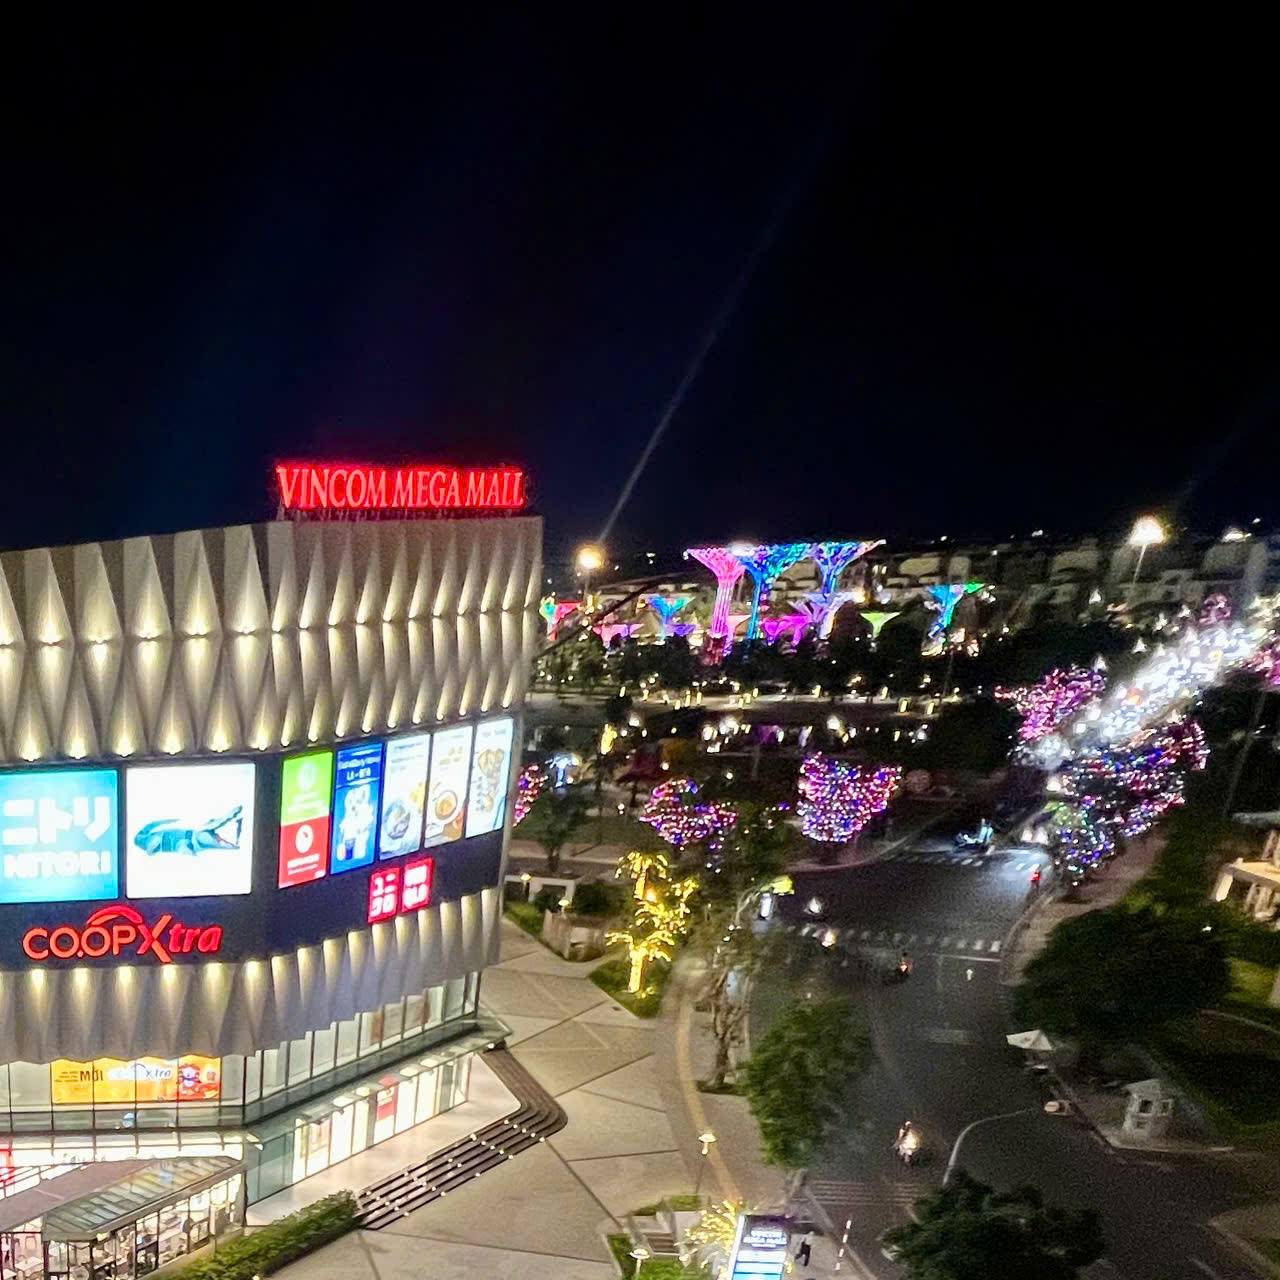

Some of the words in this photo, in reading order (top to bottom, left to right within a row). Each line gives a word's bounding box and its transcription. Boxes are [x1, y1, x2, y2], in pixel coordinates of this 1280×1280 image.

[275, 467, 388, 509] VINCOM
[391, 469, 461, 509] MEGA
[464, 470, 524, 508] MALL
[2, 796, 111, 845] ニトリ
